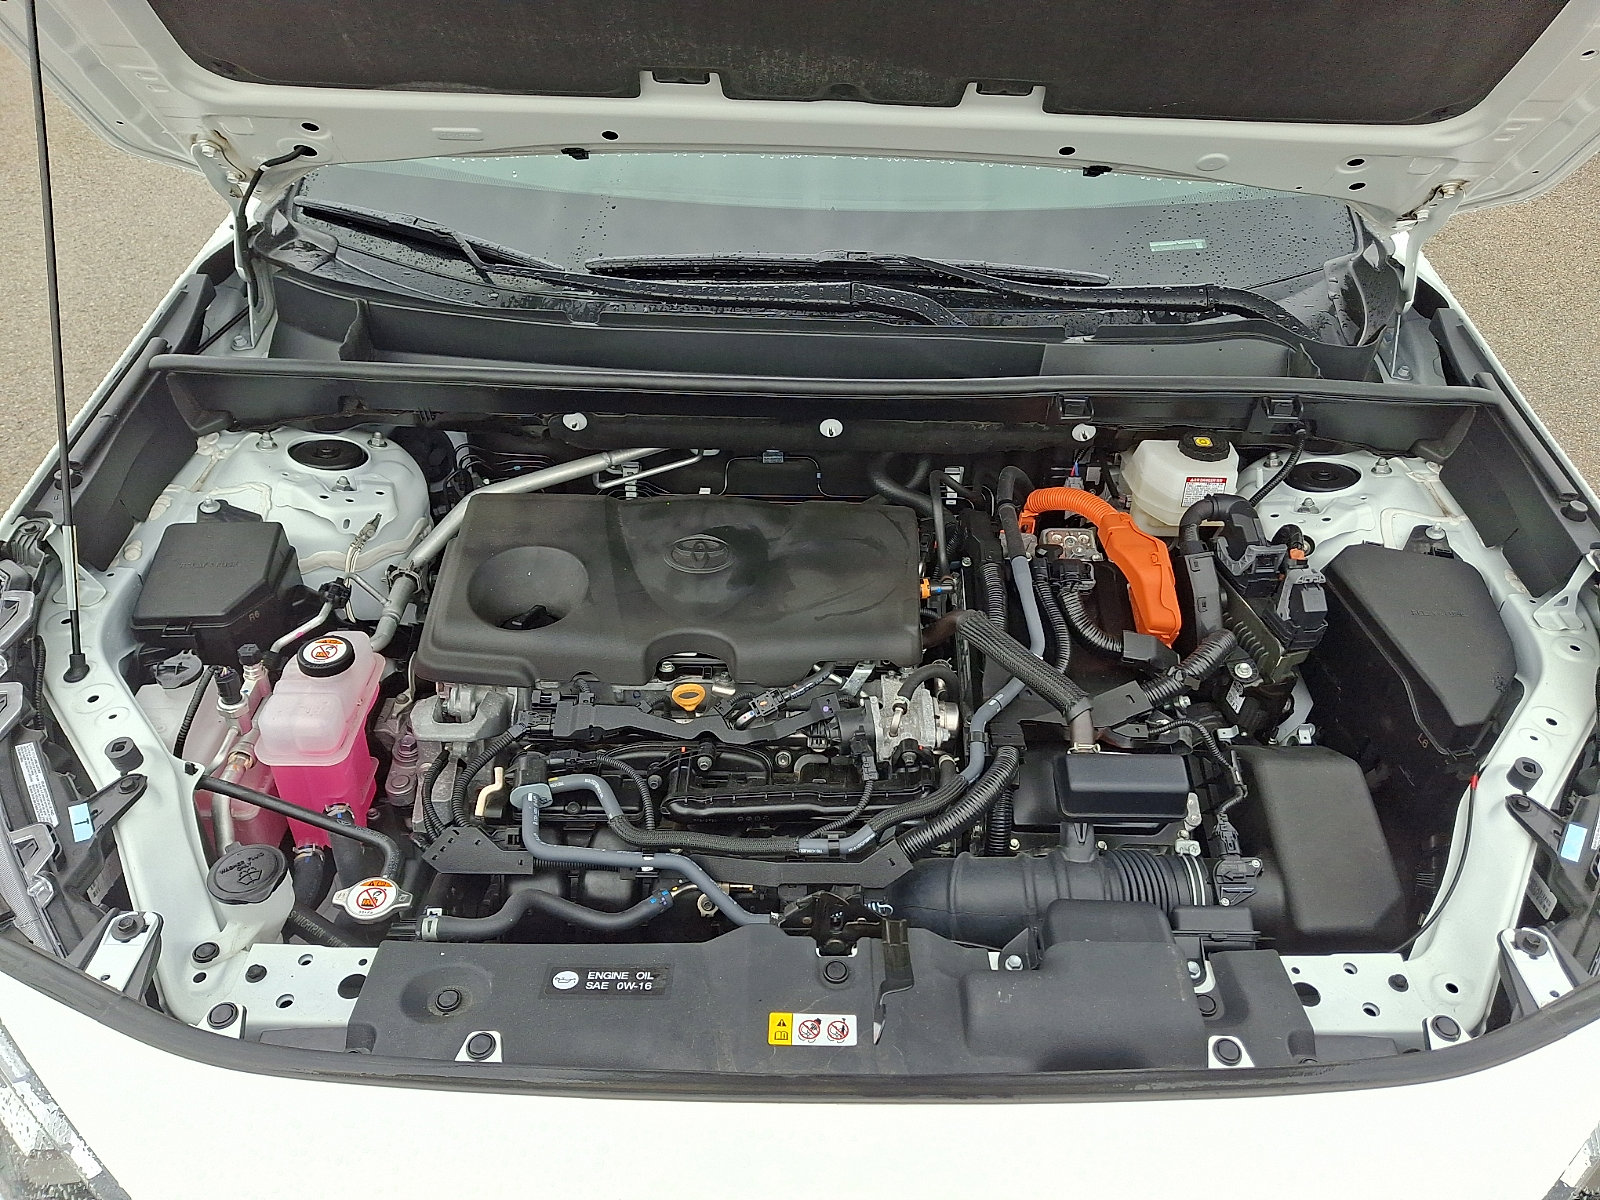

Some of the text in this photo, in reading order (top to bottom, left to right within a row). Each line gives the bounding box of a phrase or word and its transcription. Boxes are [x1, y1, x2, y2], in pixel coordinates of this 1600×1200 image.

[219, 852, 265, 875] WASHER FLUID
[236, 861, 252, 872] ONLY
[587, 971, 655, 980] ENGINE OIL
[585, 981, 652, 990] SAE 0W-16
